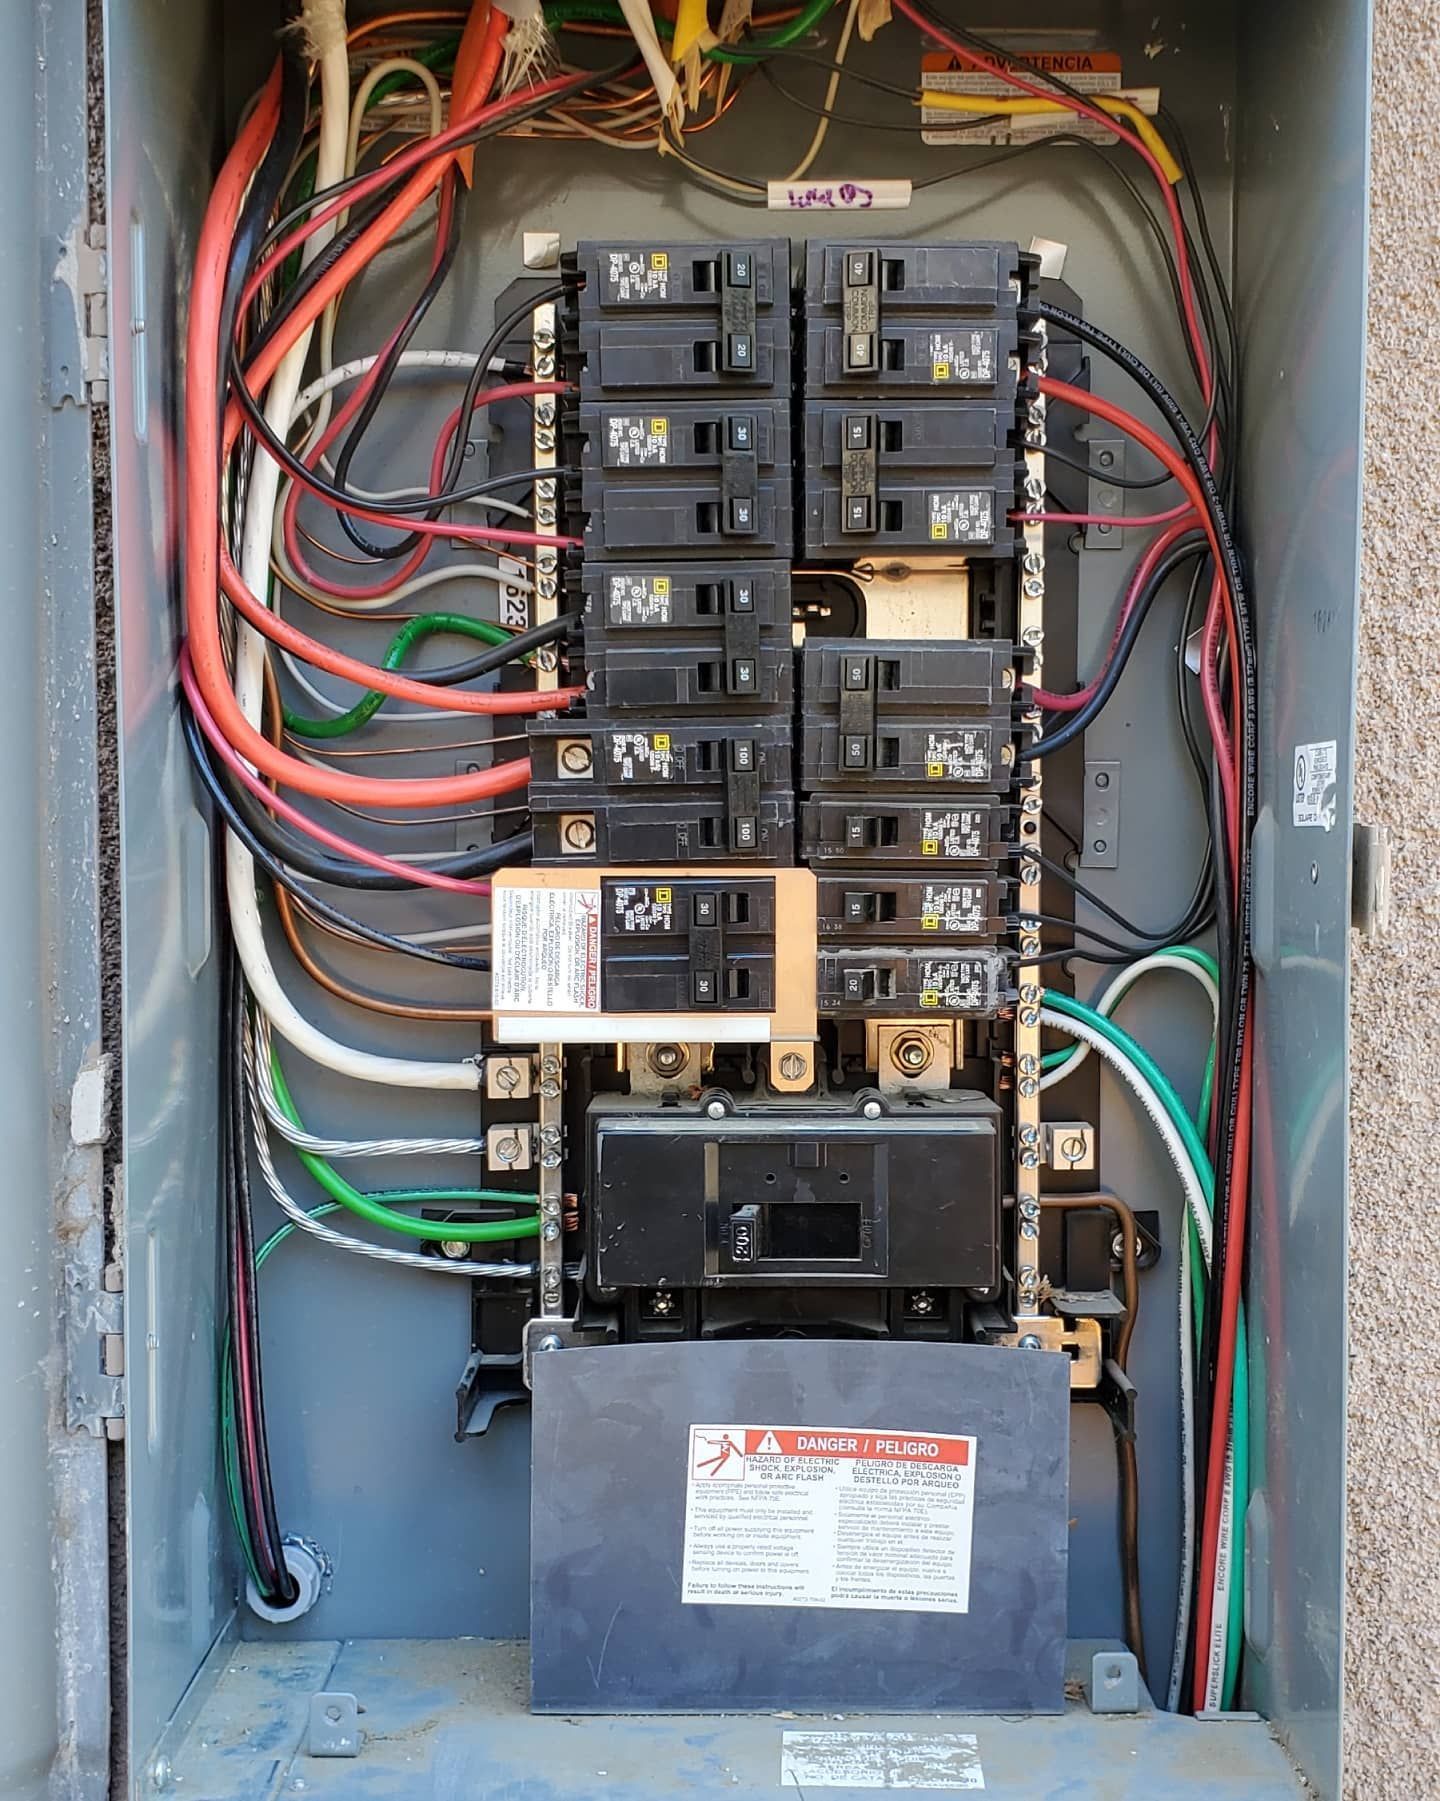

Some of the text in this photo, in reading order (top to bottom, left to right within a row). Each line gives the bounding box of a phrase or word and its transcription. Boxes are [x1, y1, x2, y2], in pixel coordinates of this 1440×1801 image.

[972, 55, 1093, 71] DVTENCIA
[736, 263, 746, 276] 20
[855, 262, 863, 276] 40
[1096, 332, 1117, 350] TYPE
[737, 344, 746, 357] 20
[856, 344, 865, 357] 40
[1139, 366, 1150, 378] OR
[1162, 393, 1178, 414] 600V
[737, 427, 746, 441] 30
[853, 427, 862, 439] 15
[1189, 438, 1201, 455] GR2
[1207, 479, 1216, 494] OR
[739, 508, 748, 522] 30
[853, 507, 862, 519] 15
[1223, 533, 1233, 548] OR
[1235, 577, 1242, 591] OR
[739, 589, 748, 603] 30
[1238, 592, 1247, 614] MTW
[1243, 617, 1251, 640] TYPE
[740, 667, 749, 681] 30
[852, 668, 861, 681] 50
[738, 748, 748, 765] 100
[852, 744, 860, 756] 50
[1247, 776, 1255, 816] ENCORE
[741, 823, 751, 841] 100
[852, 826, 860, 839] 15
[700, 903, 709, 915] 30
[852, 904, 860, 915] 15
[515, 939, 520, 949] OU
[555, 941, 560, 950] DE
[589, 926, 597, 963] DANGER
[574, 957, 579, 966] OR
[588, 969, 596, 1008] PELIGRO
[699, 980, 708, 993] 30
[849, 980, 858, 992] 20
[1239, 997, 1248, 1011] OR
[1236, 1013, 1246, 1045] NYLON
[1233, 1066, 1241, 1088] TYPE
[736, 1226, 749, 1254] 200
[797, 1436, 939, 1457] DANGER / PELIGRO
[749, 1464, 836, 1474] SHOCK, EXPLOSION,
[855, 1460, 894, 1468] PELIGRO
[910, 1463, 958, 1472] DESCARGA
[854, 1476, 959, 1489] DESTELLO POR ARQUEO
[1219, 1527, 1229, 1549] WIRE
[1216, 1553, 1228, 1591] ENCORE
[1209, 1623, 1222, 1708] SUPERSLICK ELITE
